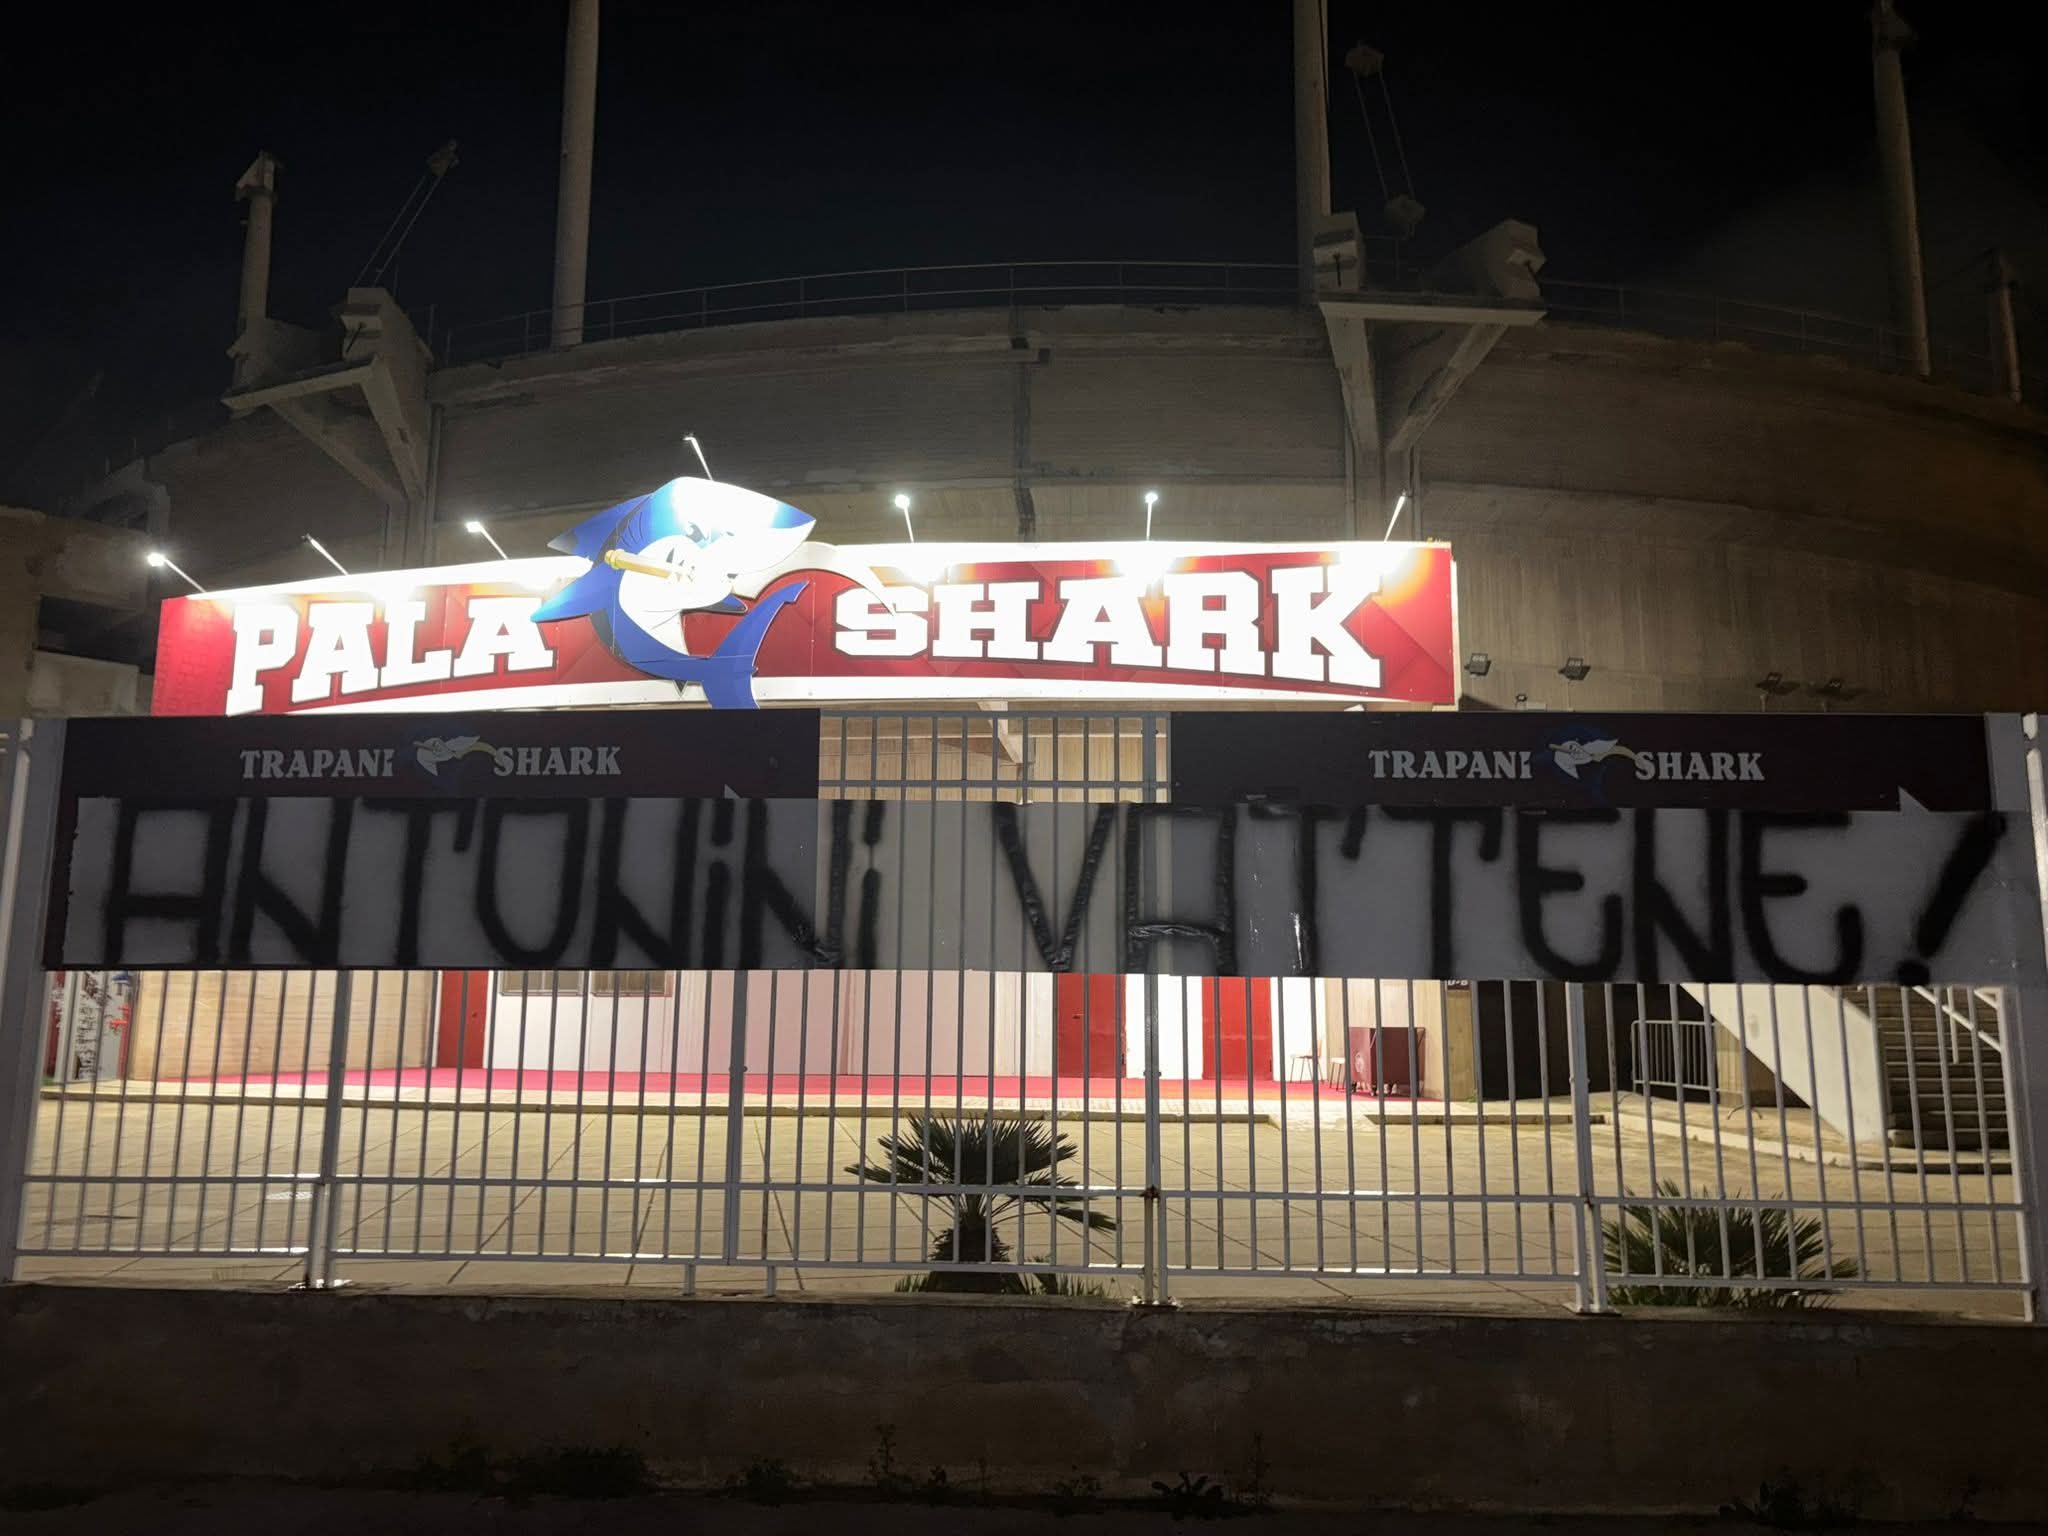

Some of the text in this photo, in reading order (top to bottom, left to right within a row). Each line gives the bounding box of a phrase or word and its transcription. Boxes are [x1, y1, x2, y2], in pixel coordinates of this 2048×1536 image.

[226, 563, 1383, 716] PALA SHARK
[493, 746, 622, 777] SHARK
[1634, 751, 1766, 782] SHARK
[991, 802, 2007, 986] VATTENE!
